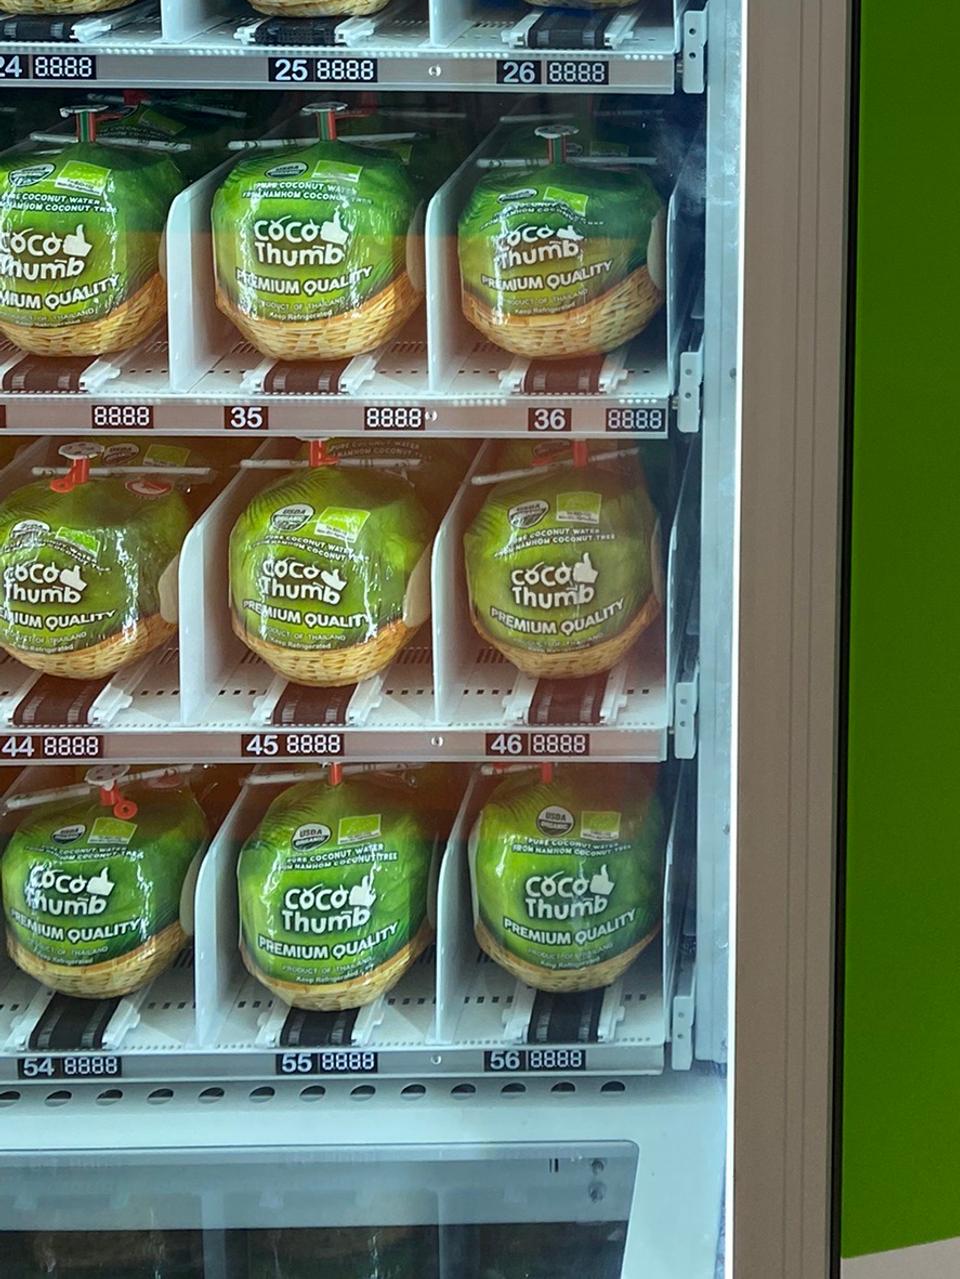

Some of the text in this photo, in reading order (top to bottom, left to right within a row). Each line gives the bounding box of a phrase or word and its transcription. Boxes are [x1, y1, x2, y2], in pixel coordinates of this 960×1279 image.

[275, 59, 308, 81] 25
[503, 62, 535, 83] 26
[255, 242, 344, 266] Thumb
[494, 240, 578, 269] Thumb
[237, 266, 372, 295] PREMIUM QUALITY
[482, 261, 612, 291] PREMIUM QUALITY
[46, 274, 120, 309] QUALITY
[230, 407, 263, 428] 35
[534, 409, 565, 430] 36
[4, 584, 81, 603] Thumb
[259, 577, 340, 604] Thumb
[512, 584, 594, 608] Thumb
[46, 610, 115, 630] QUALITY
[243, 600, 368, 627] PREMIUM QUALITY
[492, 598, 623, 635] PREMIUM QUALITY
[1, 735, 34, 756] 44
[246, 734, 279, 755] 45
[490, 734, 522, 754] 46
[310, 850, 351, 861] COCONUT
[27, 890, 106, 915] Thumb
[526, 896, 608, 920] Thumb
[11, 909, 140, 942] PREMIUM QUALITY
[282, 908, 370, 933] Thumb
[505, 909, 635, 944] PREMIUM QUALITY
[259, 922, 398, 959] PREMIUM QUALITY
[23, 1056, 54, 1076] 54
[281, 1052, 312, 1072] 55
[489, 1050, 520, 1070] 56
